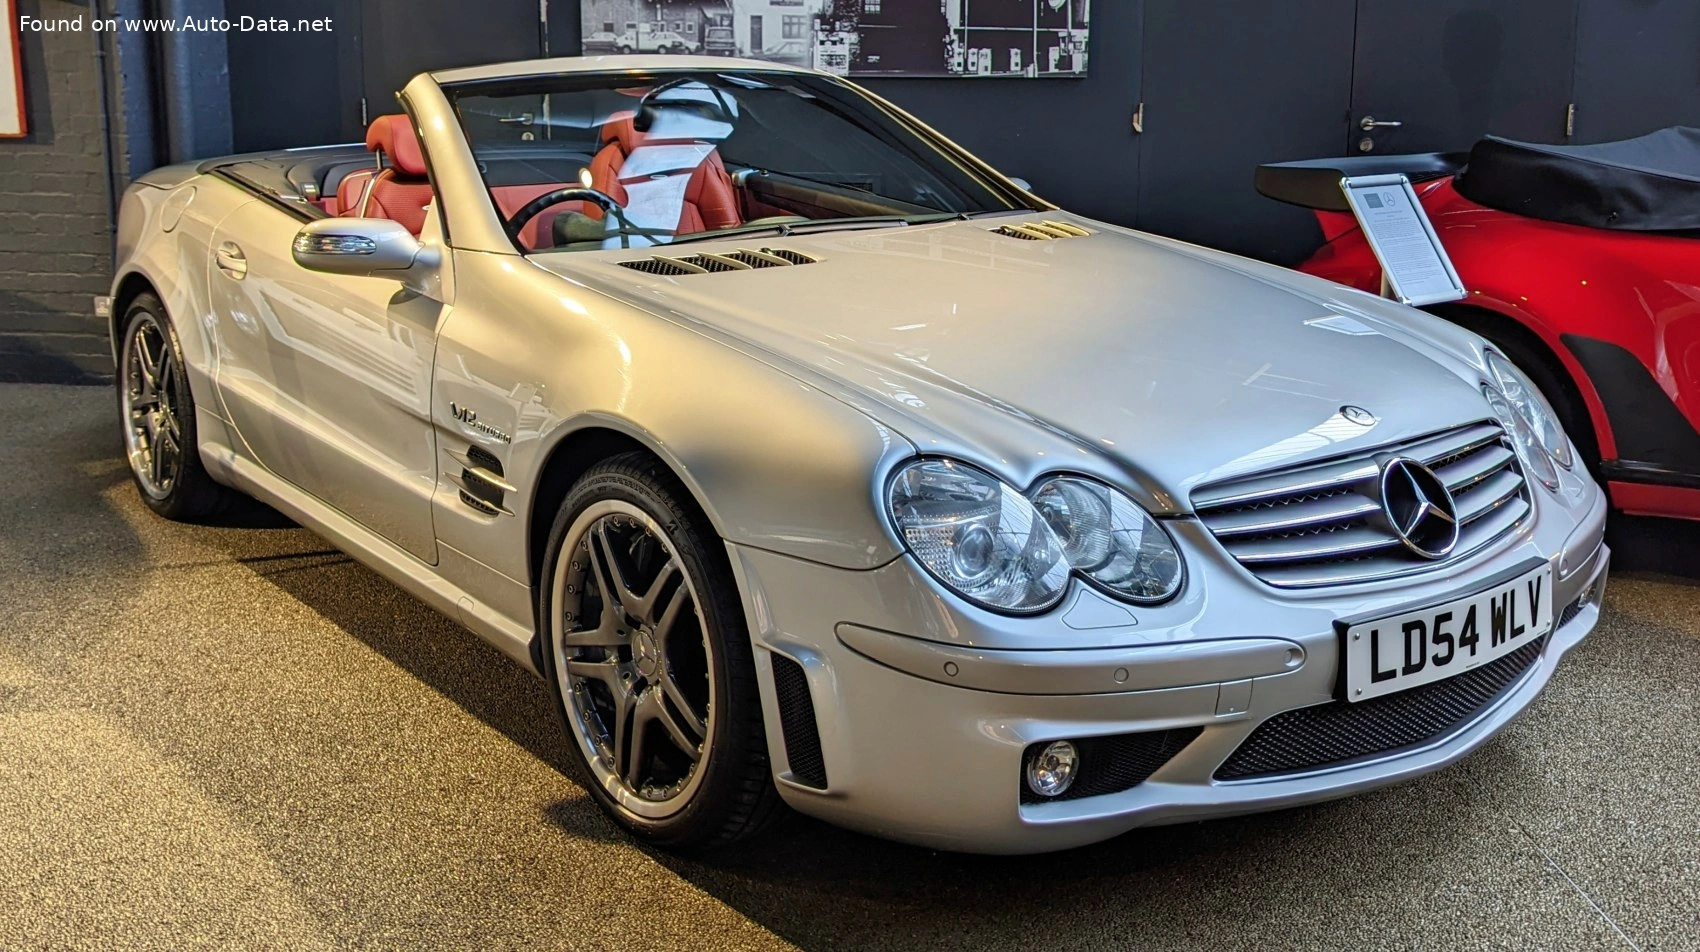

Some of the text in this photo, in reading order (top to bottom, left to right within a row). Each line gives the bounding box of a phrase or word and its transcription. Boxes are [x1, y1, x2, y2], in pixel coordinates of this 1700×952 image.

[450, 401, 477, 427] V12
[1370, 575, 1543, 684] LD54 WLV
